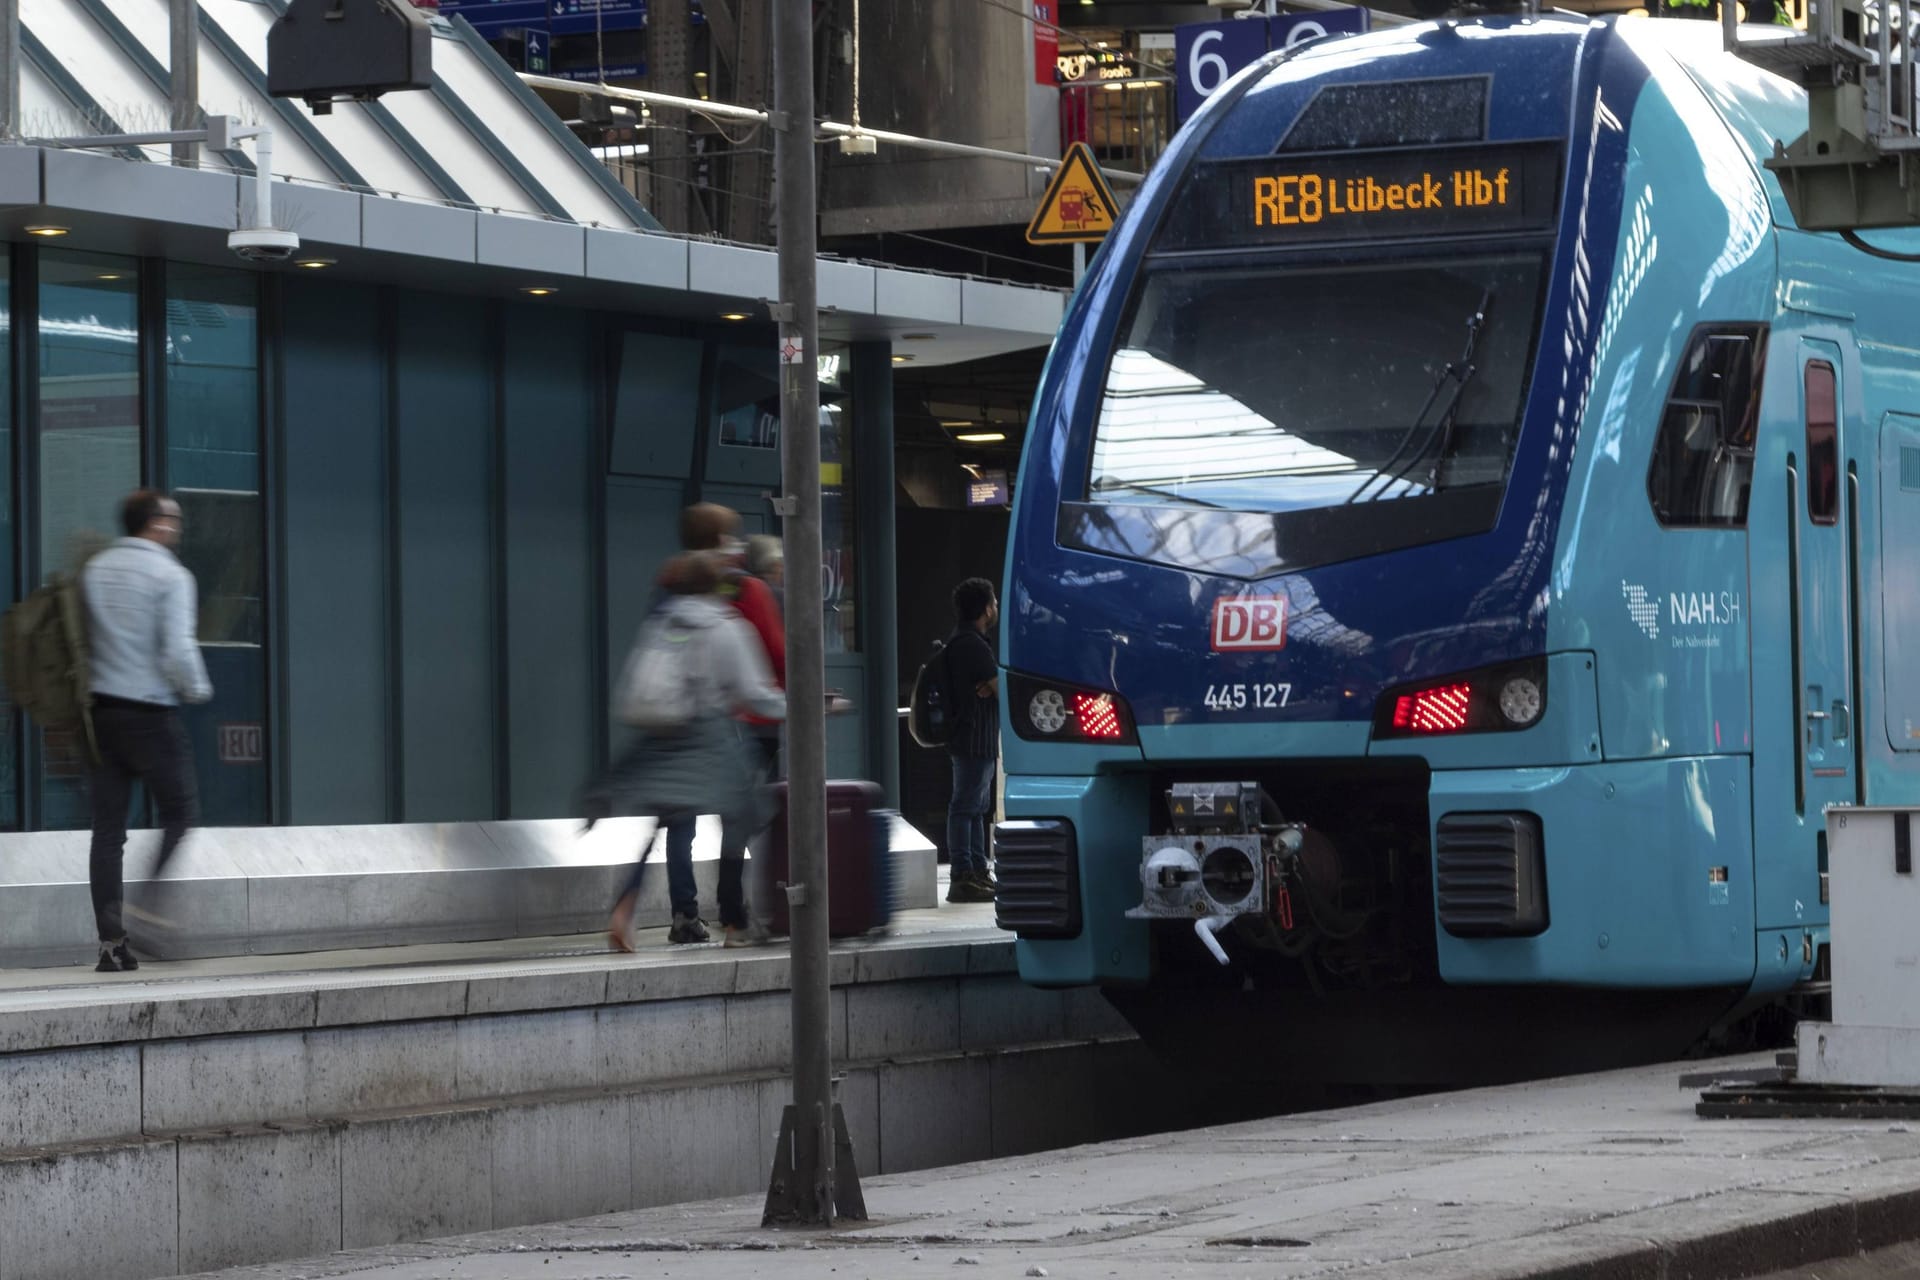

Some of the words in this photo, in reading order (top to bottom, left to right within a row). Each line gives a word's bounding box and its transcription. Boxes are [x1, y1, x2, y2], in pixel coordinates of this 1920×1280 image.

[1189, 30, 1229, 97] 6
[1254, 174, 1323, 226] RE8
[1328, 172, 1443, 213] Lübeck
[1453, 167, 1510, 206] Hbf
[1218, 602, 1281, 644] DB
[1670, 590, 1740, 625] NAH.SH
[1203, 684, 1247, 709] 445
[1253, 683, 1292, 708] 127
